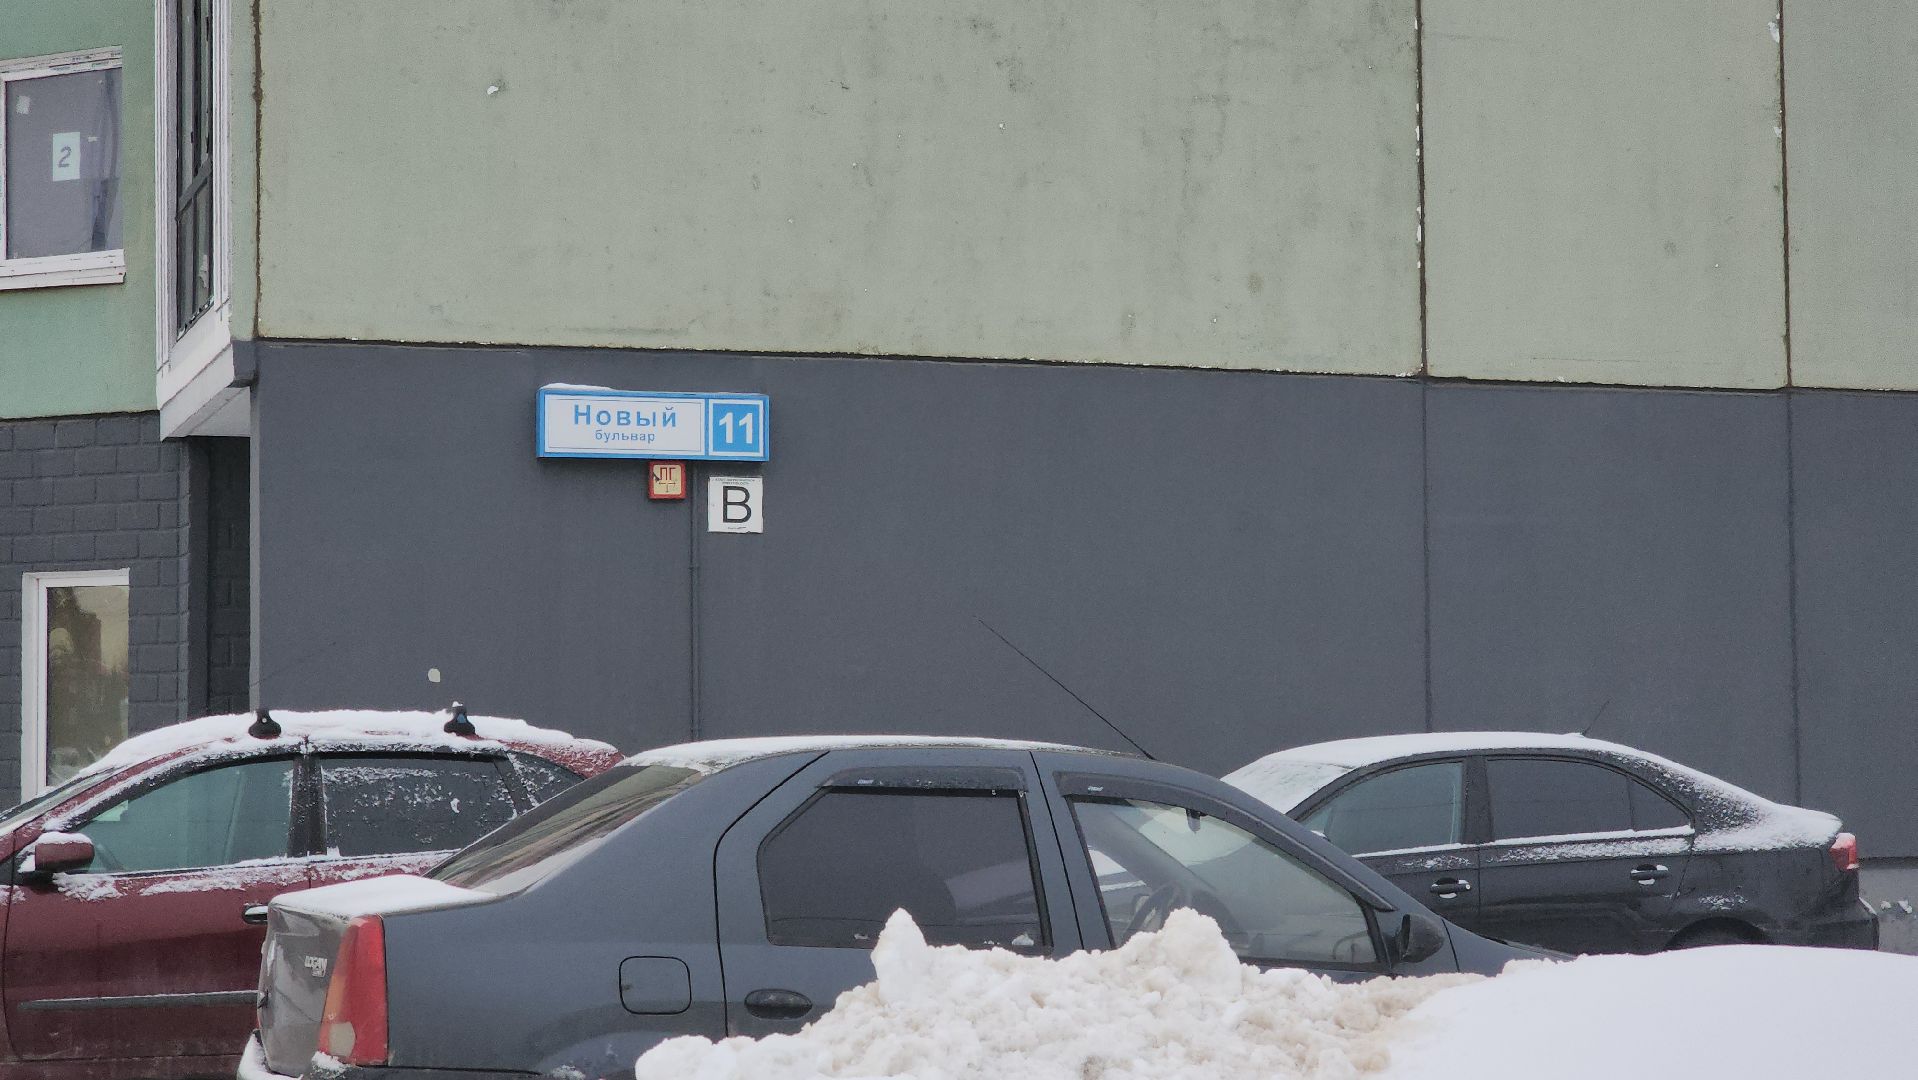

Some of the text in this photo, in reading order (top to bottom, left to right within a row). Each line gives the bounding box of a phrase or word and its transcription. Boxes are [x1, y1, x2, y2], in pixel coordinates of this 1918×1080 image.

[57, 146, 72, 168] 2
[574, 404, 677, 428] Новый
[595, 430, 655, 443] бульвар
[719, 412, 754, 444] 11
